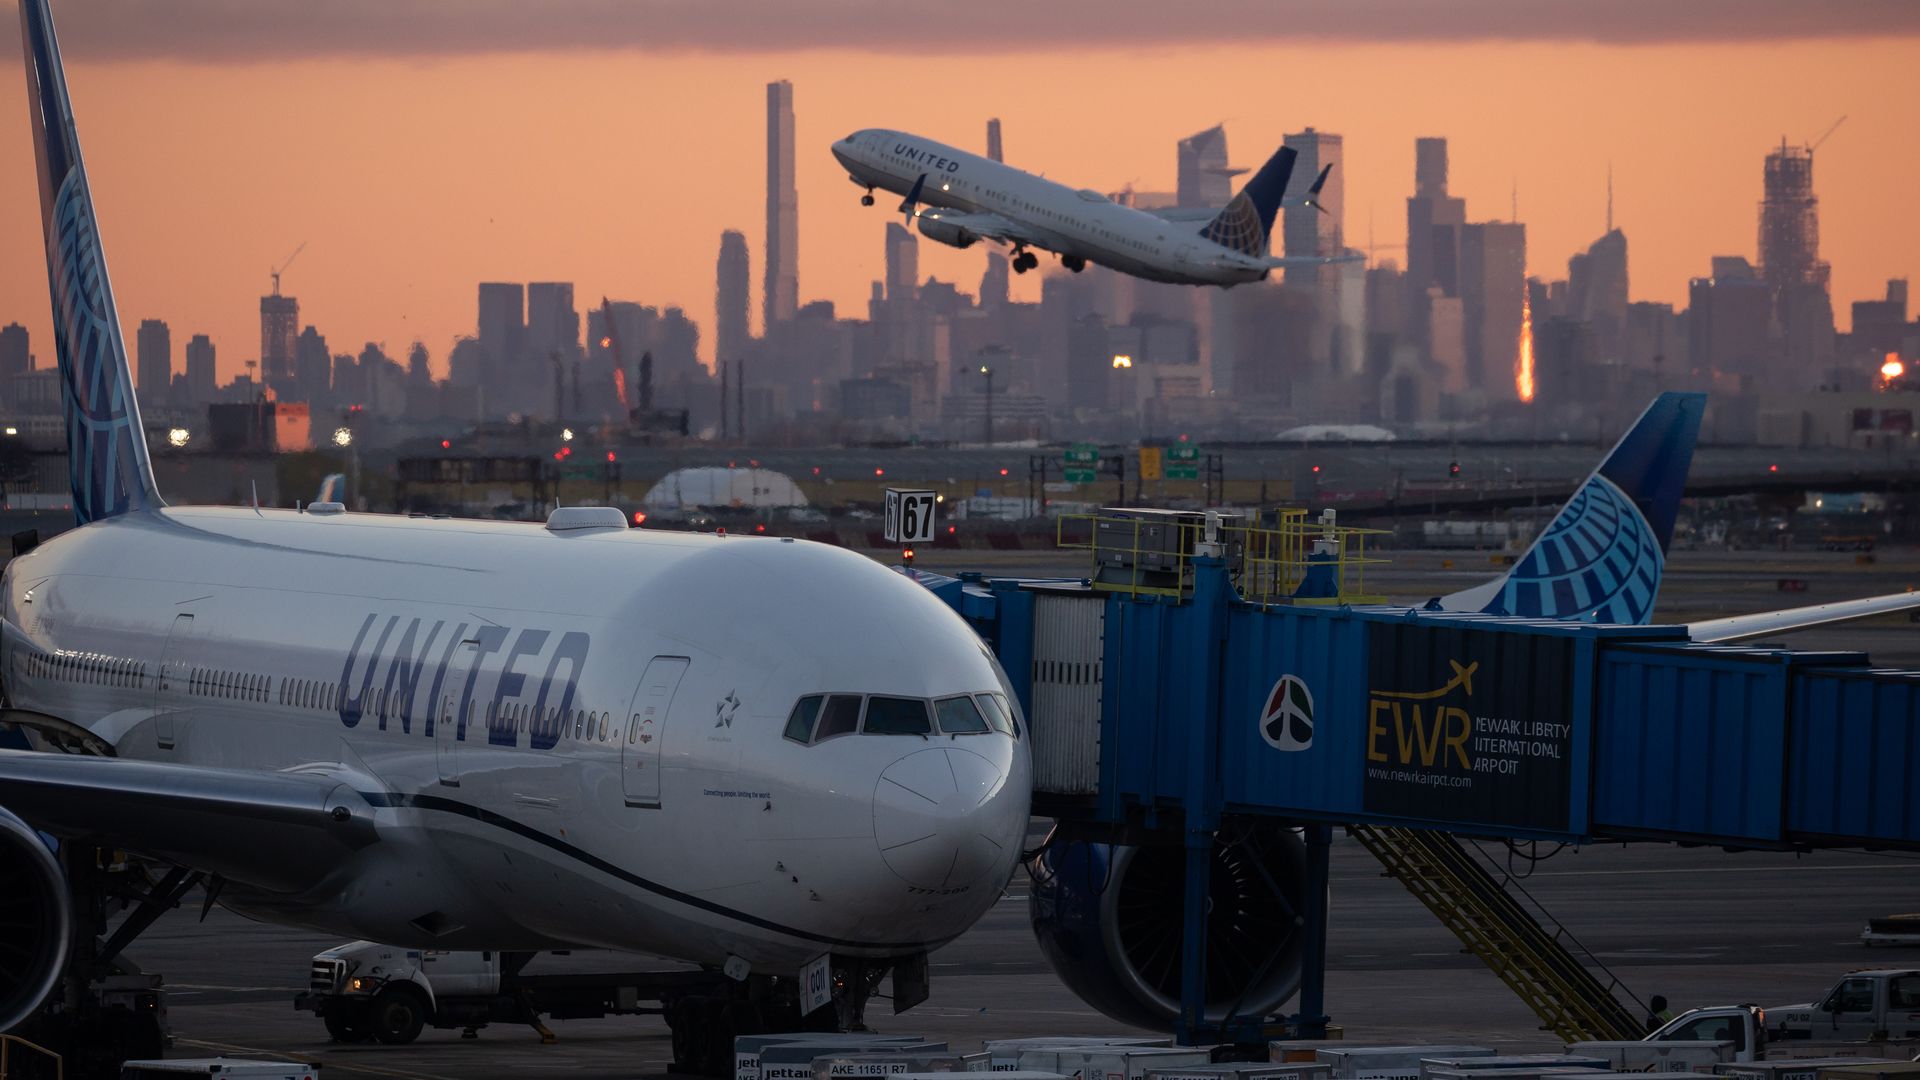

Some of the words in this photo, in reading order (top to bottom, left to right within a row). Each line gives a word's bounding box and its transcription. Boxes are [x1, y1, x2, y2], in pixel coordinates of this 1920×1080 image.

[894, 143, 960, 173] UNITED
[887, 494, 897, 538] 67
[903, 496, 933, 539] 67
[339, 613, 591, 750] UNITED
[1368, 699, 1472, 769] EWR
[908, 886, 969, 895] 777-200
[832, 1065, 855, 1074] AKE
[858, 1065, 887, 1074] 11651
[892, 1065, 905, 1074] R7
